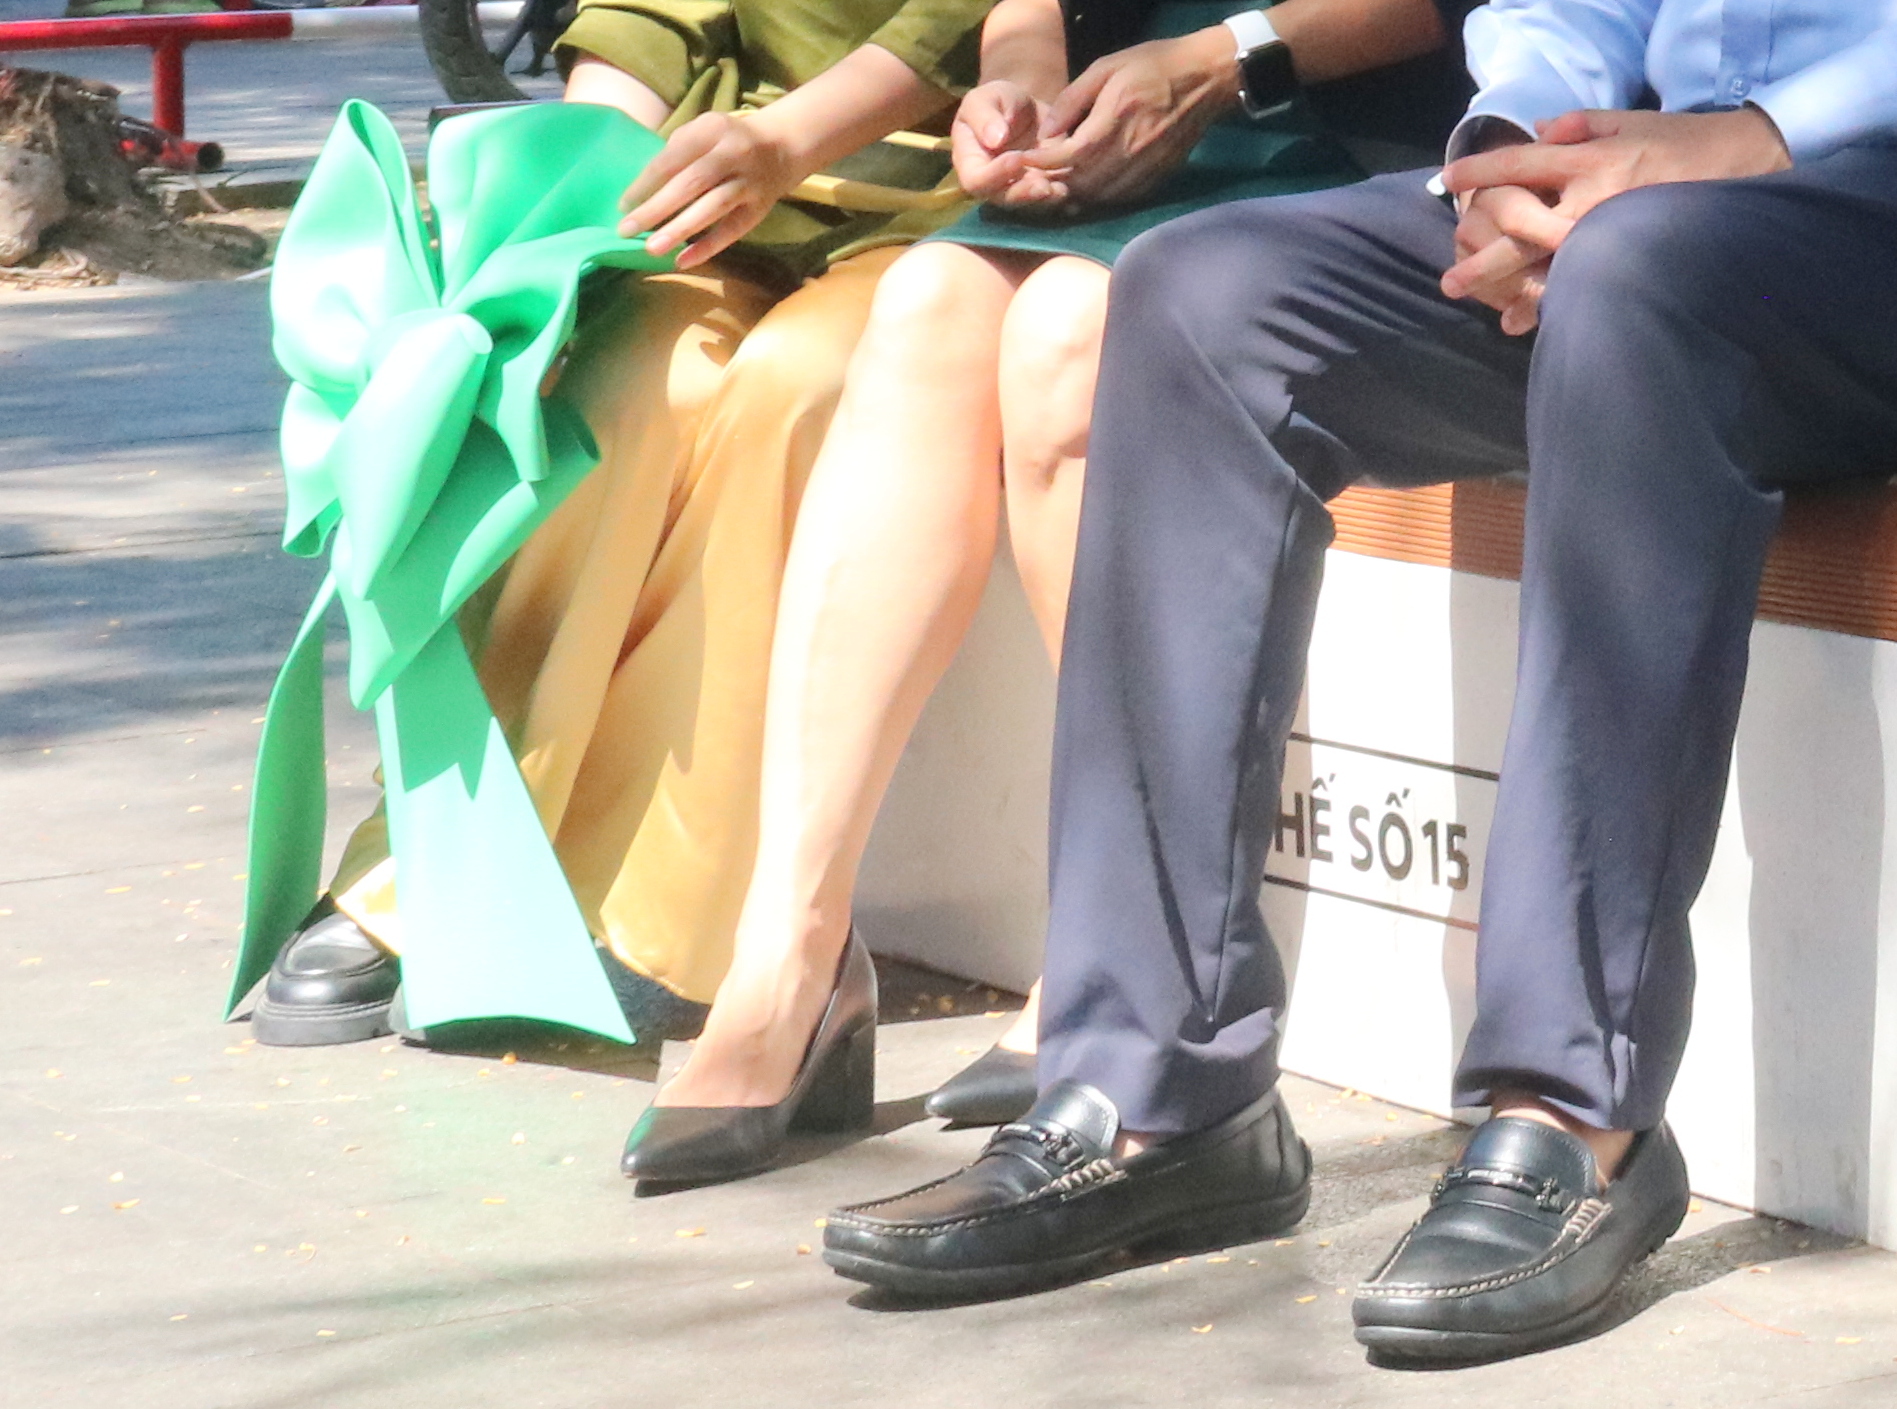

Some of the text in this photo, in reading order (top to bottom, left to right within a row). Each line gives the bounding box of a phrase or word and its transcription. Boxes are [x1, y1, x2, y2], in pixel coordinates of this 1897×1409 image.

[1273, 773, 1471, 891] HẾ SỐ 15
